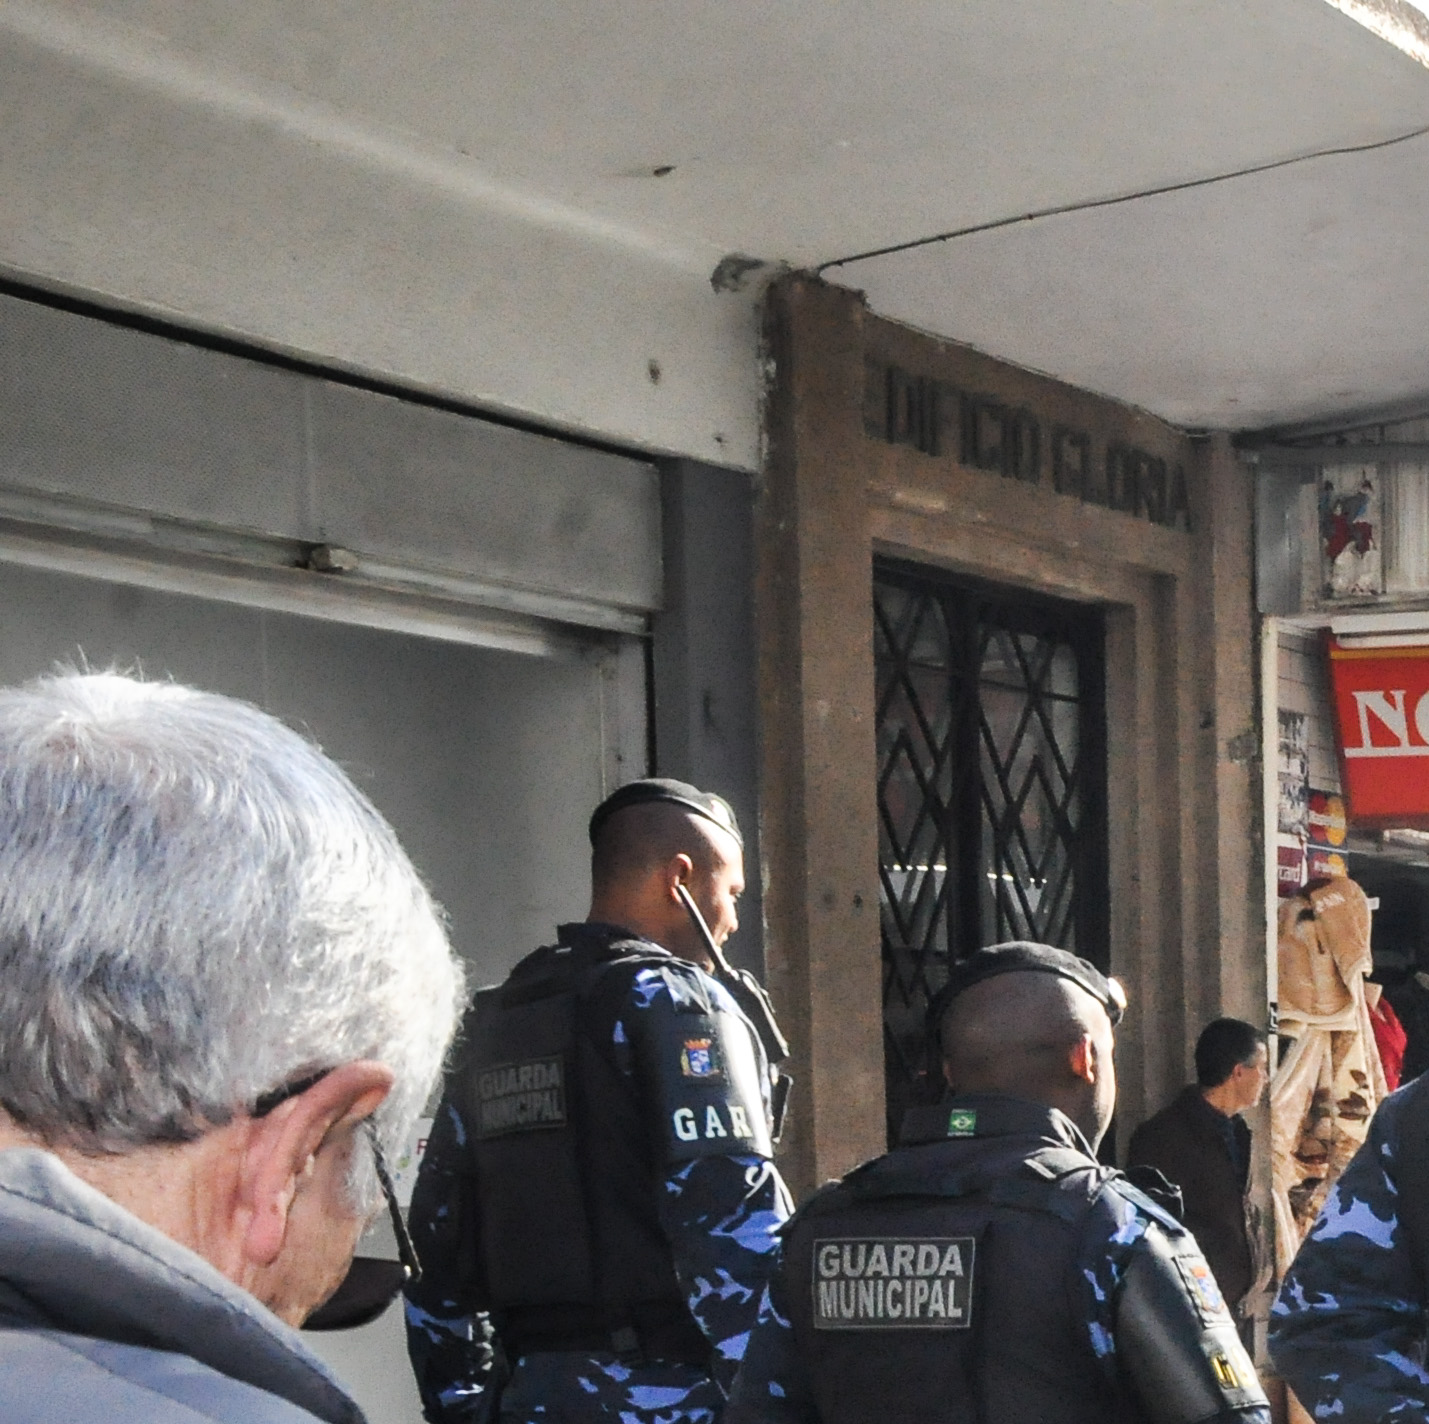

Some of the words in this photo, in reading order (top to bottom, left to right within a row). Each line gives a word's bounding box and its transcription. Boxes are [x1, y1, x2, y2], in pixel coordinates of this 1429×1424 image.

[478, 1061, 561, 1097] GUARDA
[819, 1244, 963, 1278] GUARDA
[818, 1279, 962, 1318] MUNICIPAL
